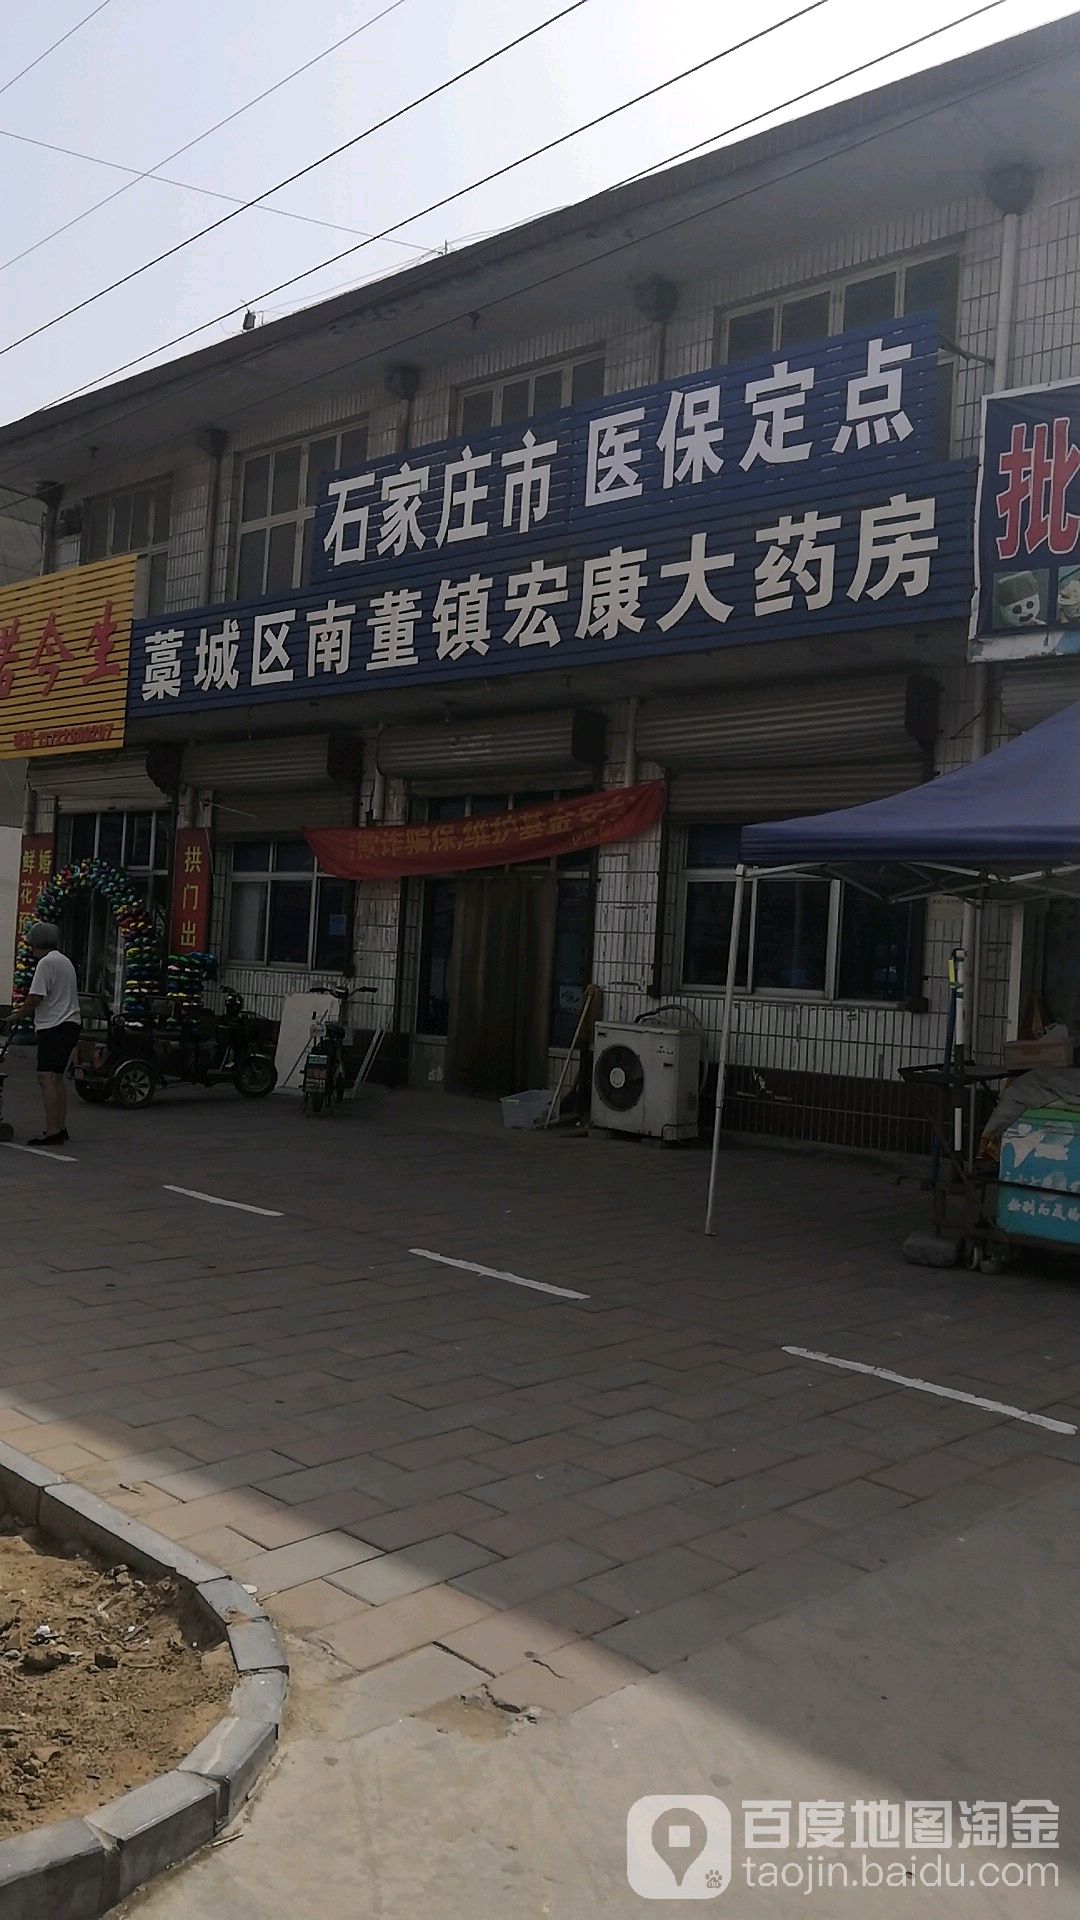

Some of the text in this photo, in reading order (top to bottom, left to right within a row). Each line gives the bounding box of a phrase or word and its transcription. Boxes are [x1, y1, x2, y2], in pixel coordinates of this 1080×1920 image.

[996, 416, 1080, 560] 批
[140, 494, 940, 703] 藁城区南董镇宏康大药房
[180, 845, 202, 948] 拱门出
